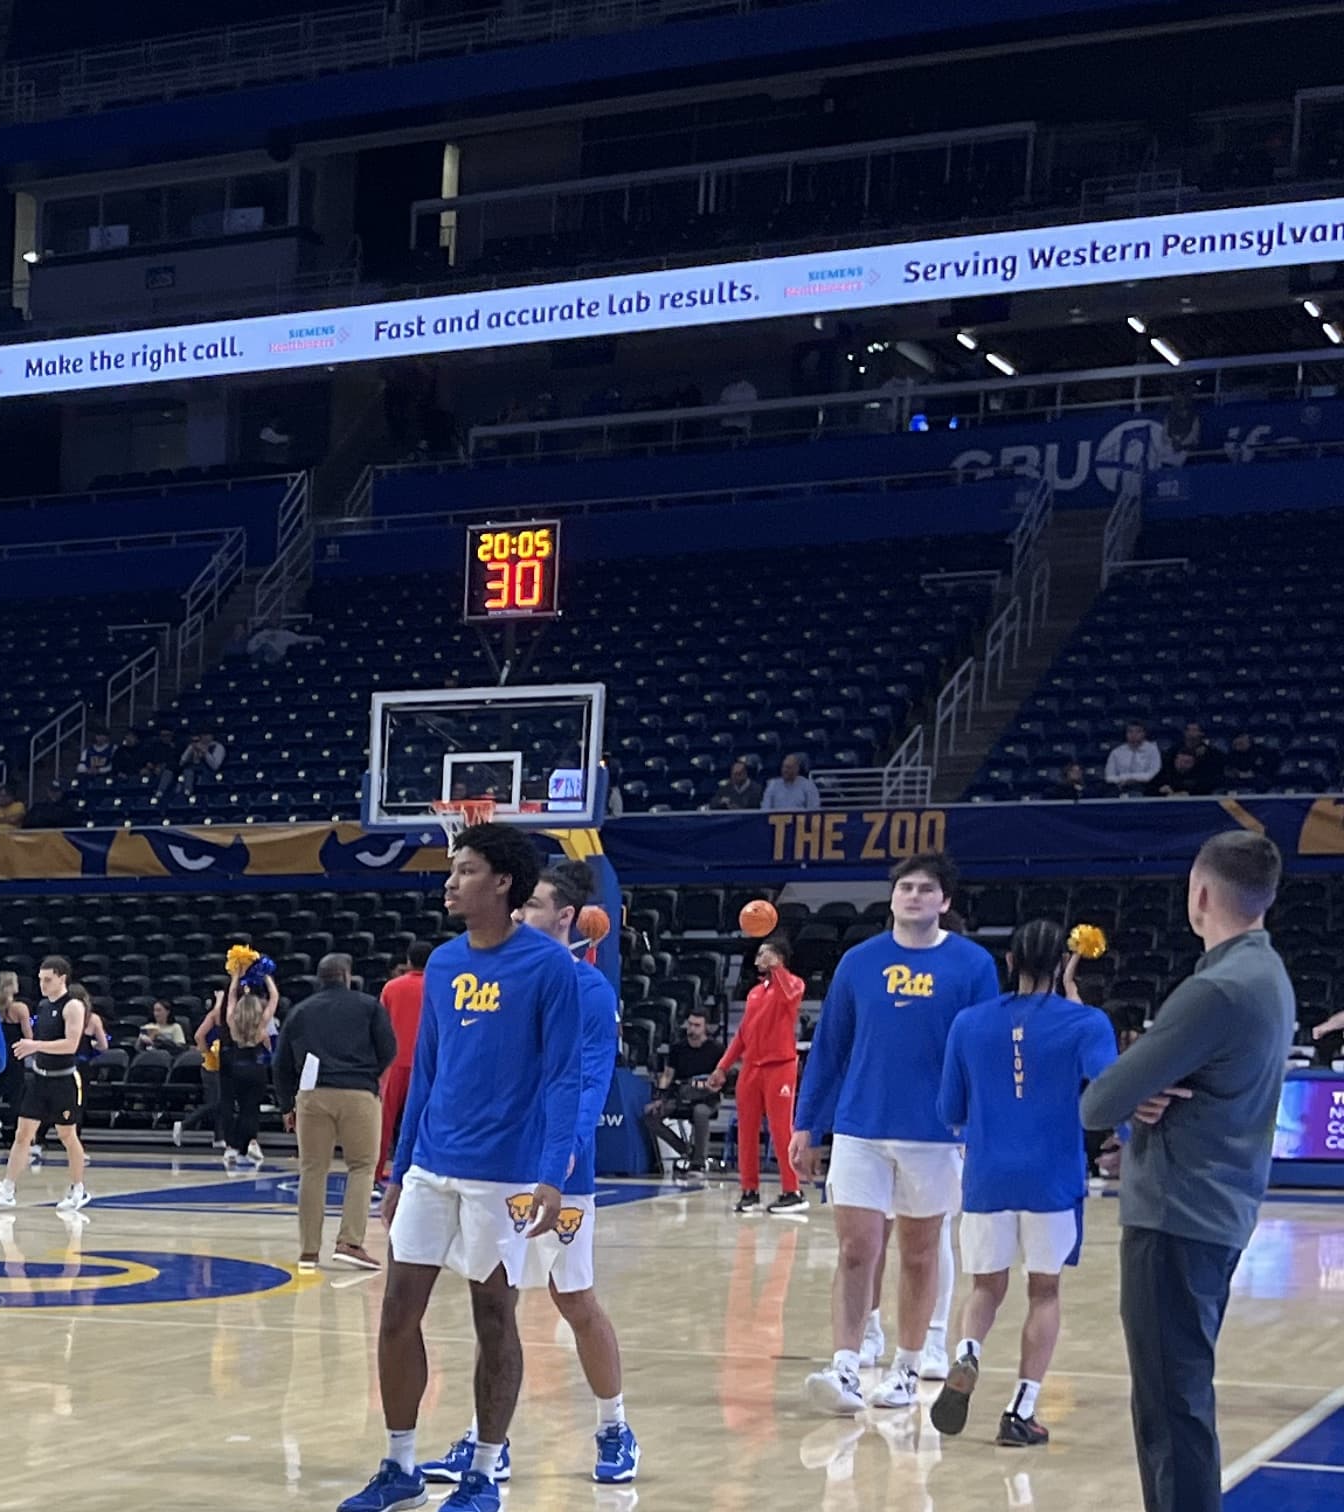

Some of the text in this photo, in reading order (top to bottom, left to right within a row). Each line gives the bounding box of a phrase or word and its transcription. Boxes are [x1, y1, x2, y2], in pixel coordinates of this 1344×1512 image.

[903, 250, 1018, 285] Serving
[1027, 239, 1152, 270] Western
[373, 279, 761, 343] Fast and accurate lab results.
[24, 335, 245, 379] Make the right call.
[477, 528, 552, 562] 20:05
[484, 559, 541, 609] 30
[768, 810, 947, 861] THE ZOO
[451, 972, 501, 1013] Pitt
[882, 964, 933, 997] Pitt
